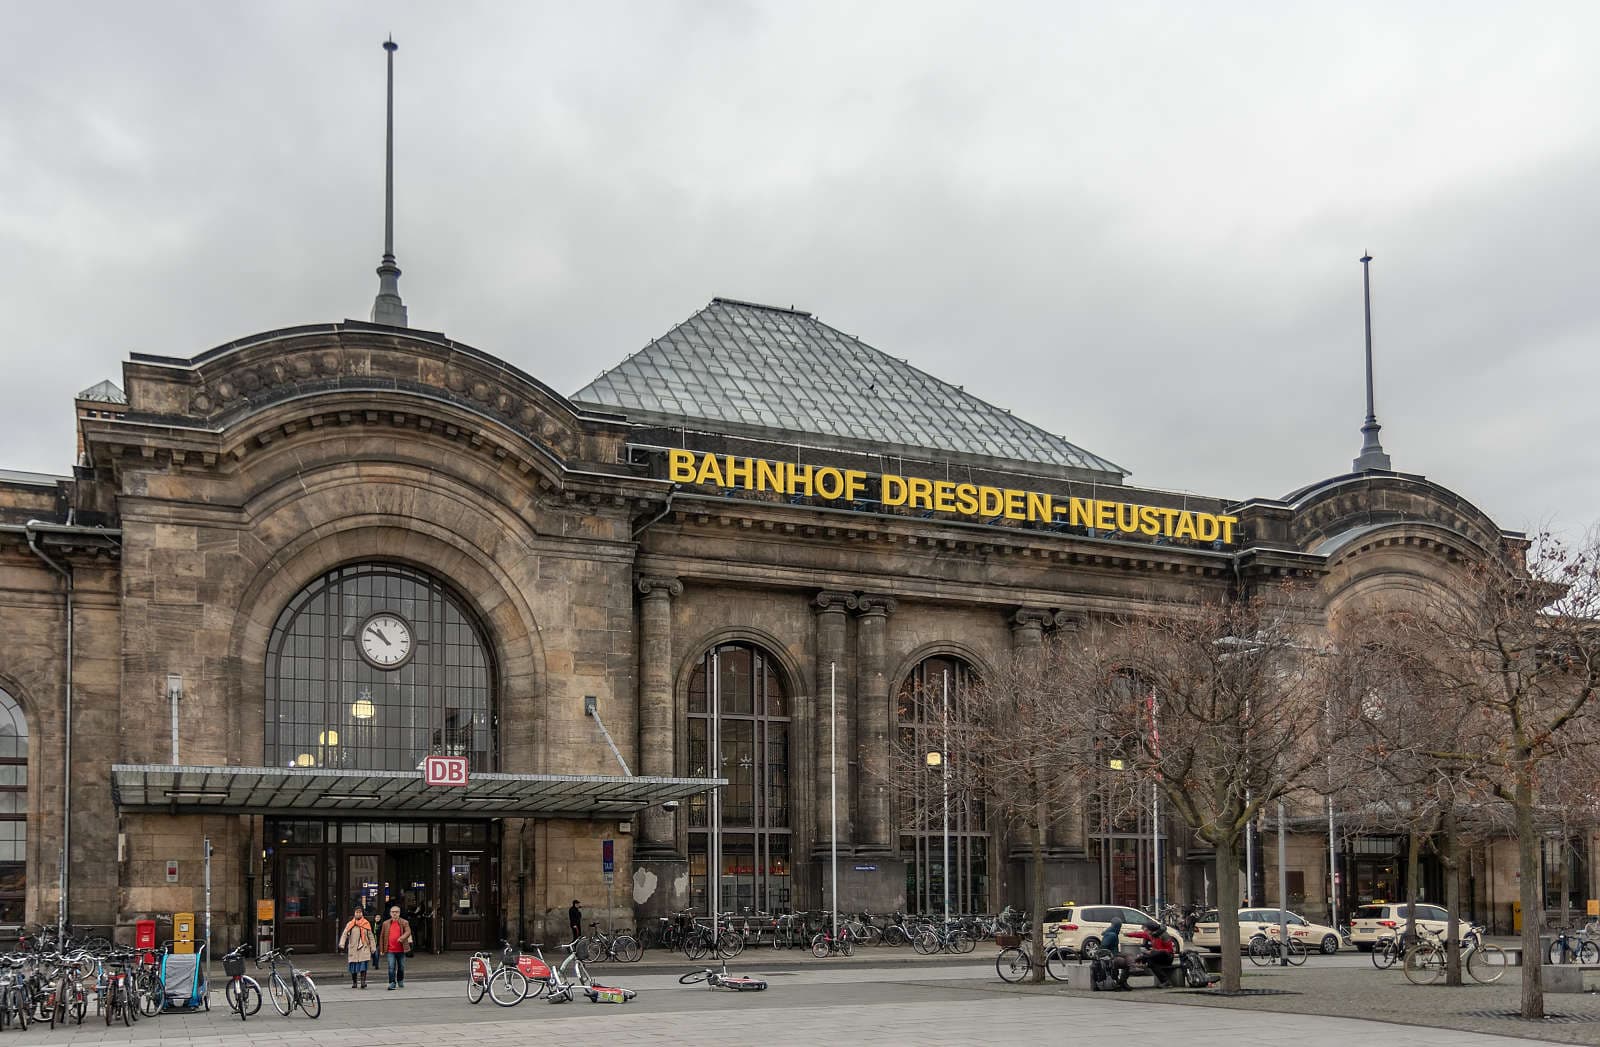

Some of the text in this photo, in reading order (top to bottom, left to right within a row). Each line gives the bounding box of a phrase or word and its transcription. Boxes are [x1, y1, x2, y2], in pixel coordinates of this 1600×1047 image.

[669, 449, 1238, 544] BAHNHOF DRESDEN-NEUSTADT
[431, 761, 463, 781] DB
